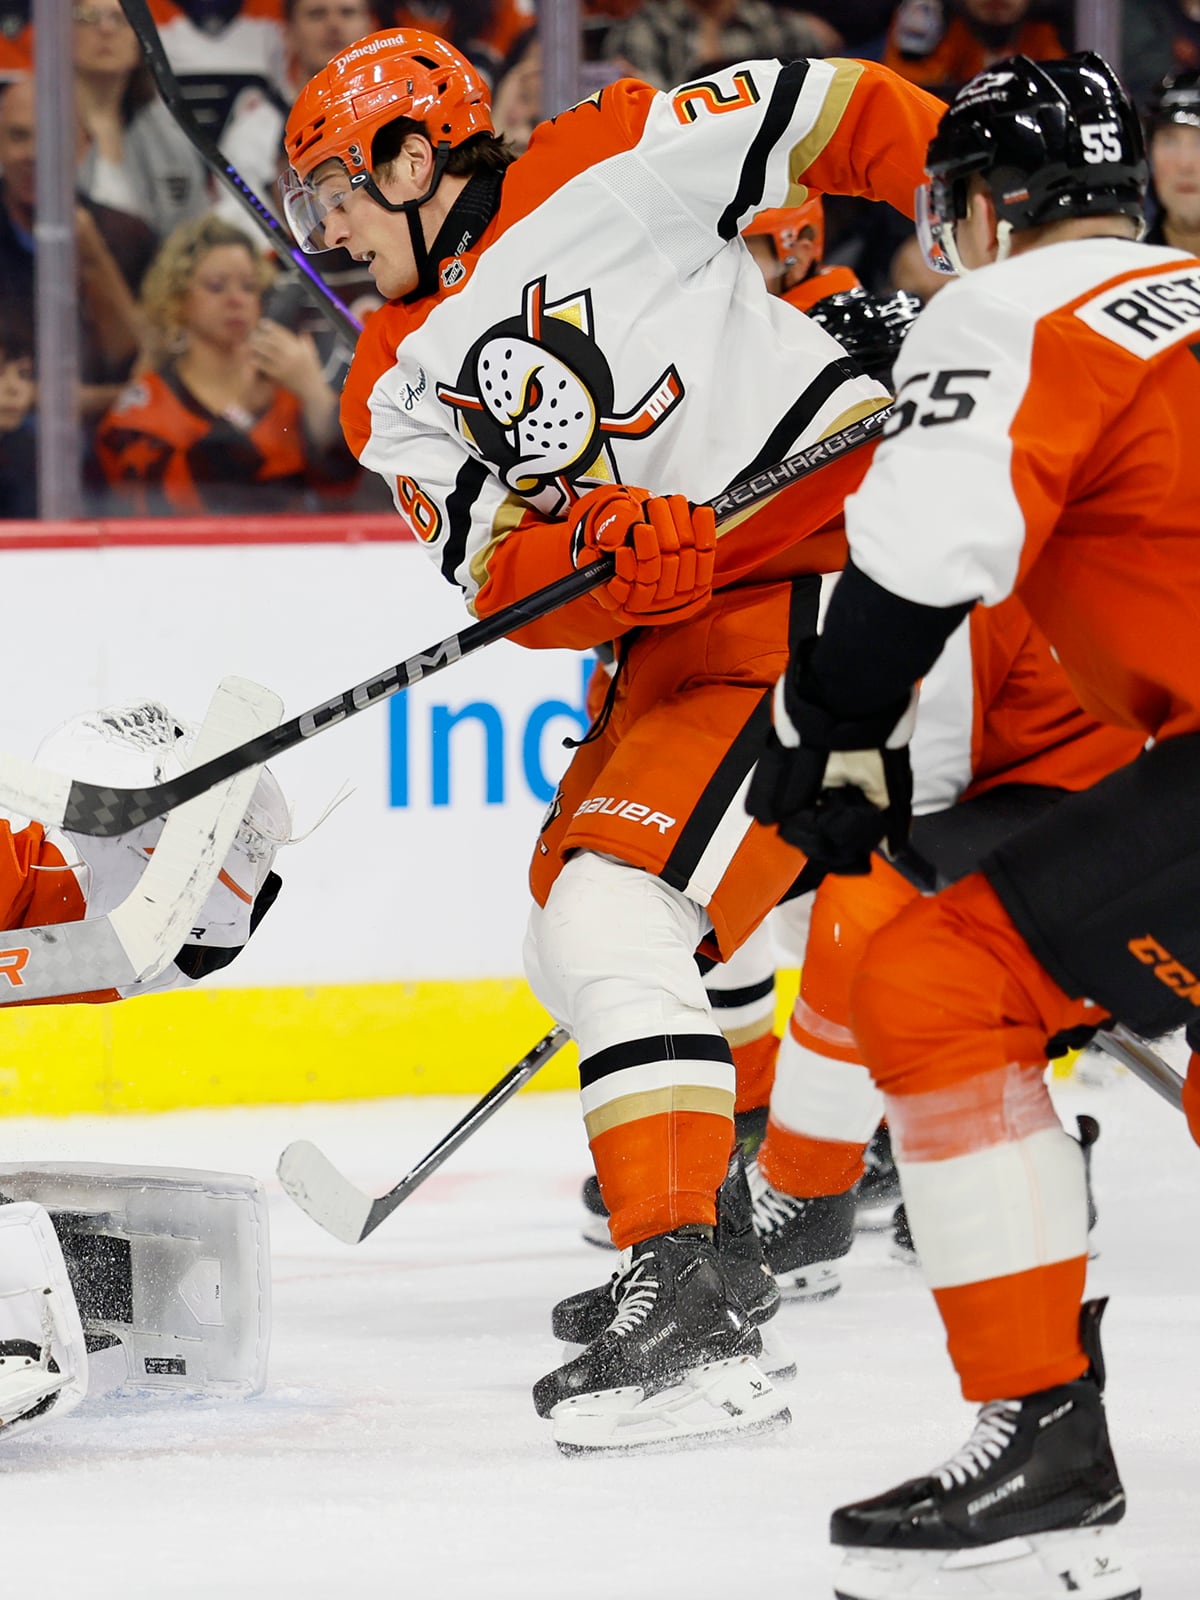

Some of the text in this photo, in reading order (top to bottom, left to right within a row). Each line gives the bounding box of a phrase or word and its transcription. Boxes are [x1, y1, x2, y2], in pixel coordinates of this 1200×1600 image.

[333, 34, 405, 75] Disneyland
[672, 70, 761, 125] 2
[1080, 122, 1122, 164] 55
[712, 425, 867, 514] RECHARGE
[396, 474, 443, 543] 8
[299, 633, 462, 738] CCM
